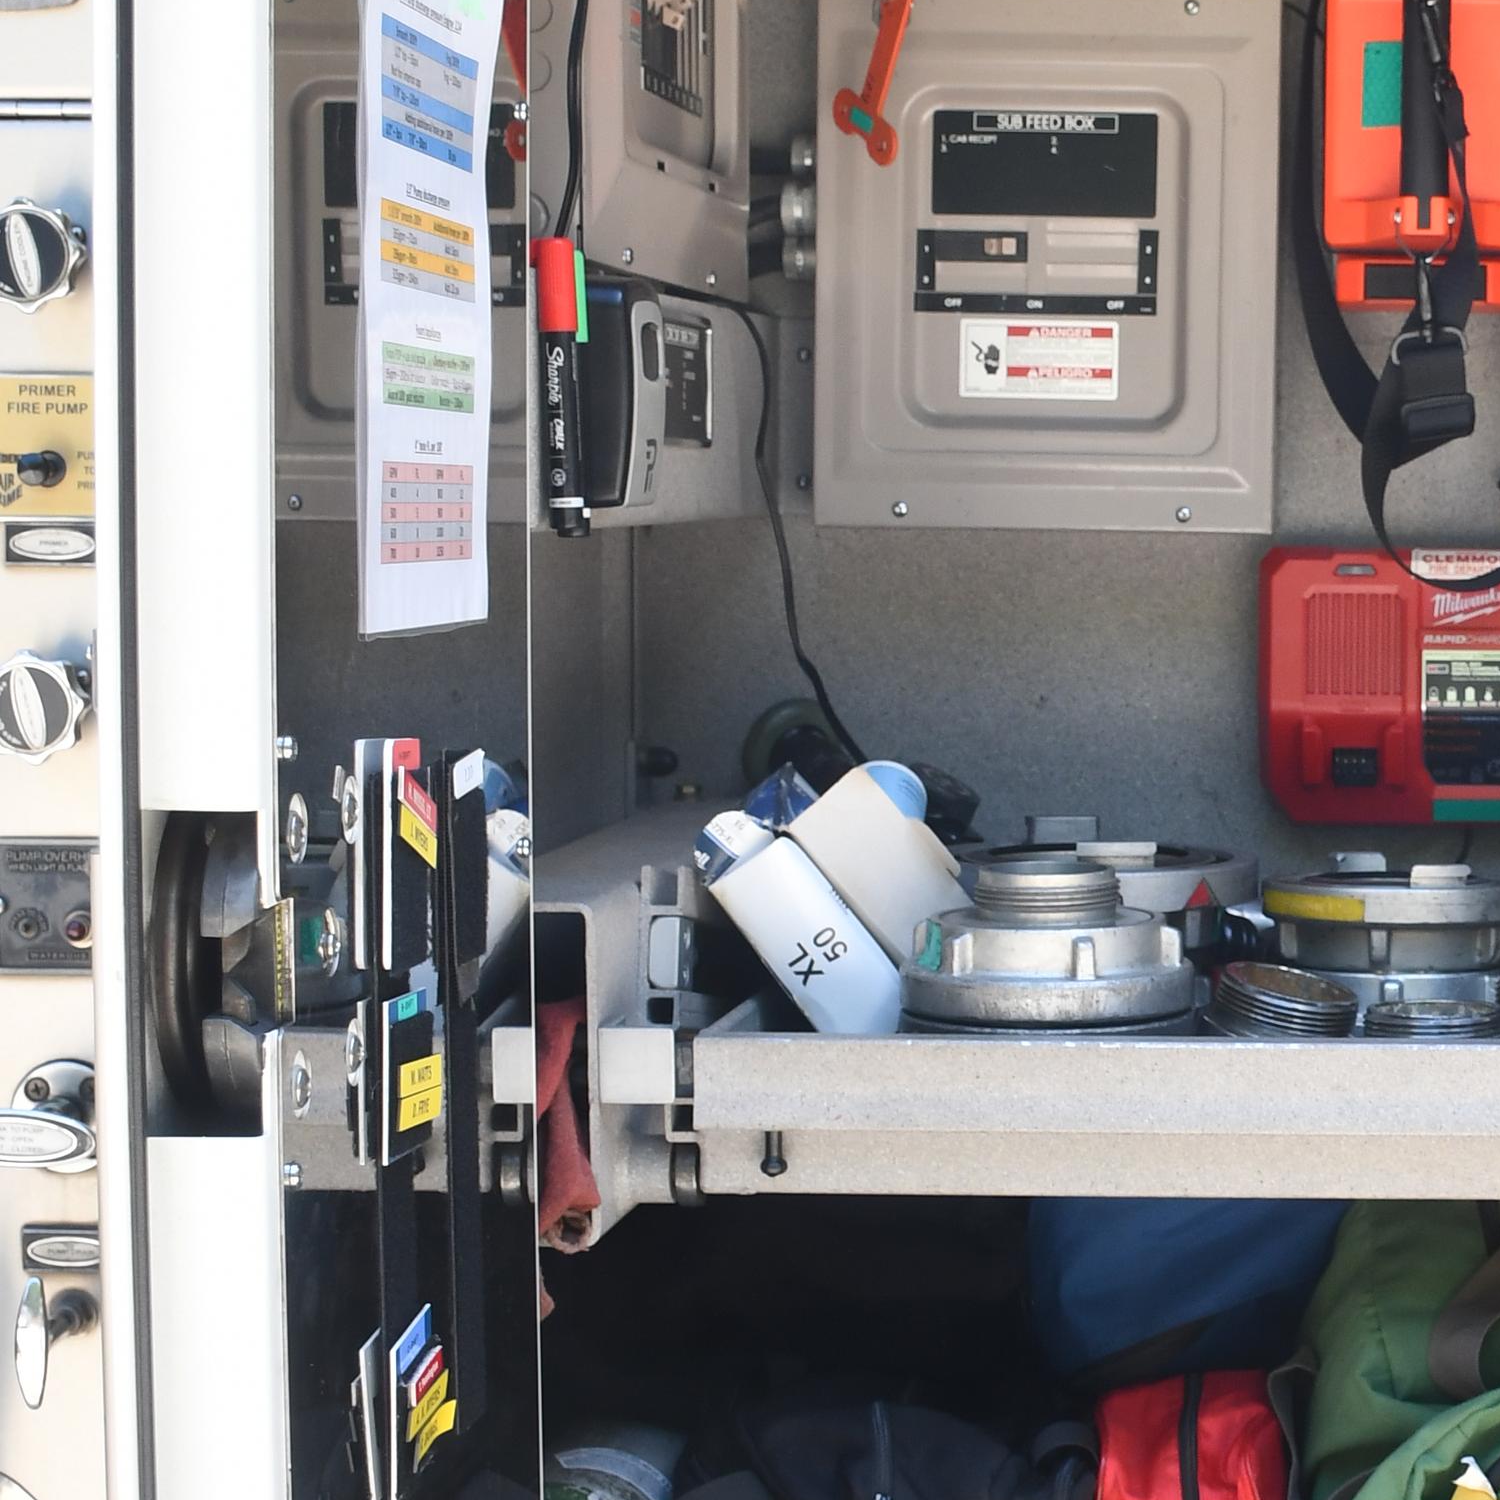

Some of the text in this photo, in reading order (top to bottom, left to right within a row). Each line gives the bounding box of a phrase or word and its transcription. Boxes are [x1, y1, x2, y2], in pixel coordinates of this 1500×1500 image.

[997, 114, 1096, 131] SUB FEED BOX
[950, 134, 968, 144] CAB
[944, 297, 962, 307] OFF
[1026, 300, 1043, 309] ON
[1106, 301, 1125, 310] OFF
[1039, 328, 1092, 338] DANGER
[544, 342, 565, 407] Sharpie
[1036, 368, 1093, 379] PELIGRO
[18, 384, 76, 397] PRIMER
[7, 402, 88, 415] FIRE PUMP
[554, 417, 565, 450] CHALK
[77, 451, 95, 461] PUS
[45, 850, 87, 862] OVERH
[813, 927, 848, 963] 50
[788, 942, 825, 987] XL
